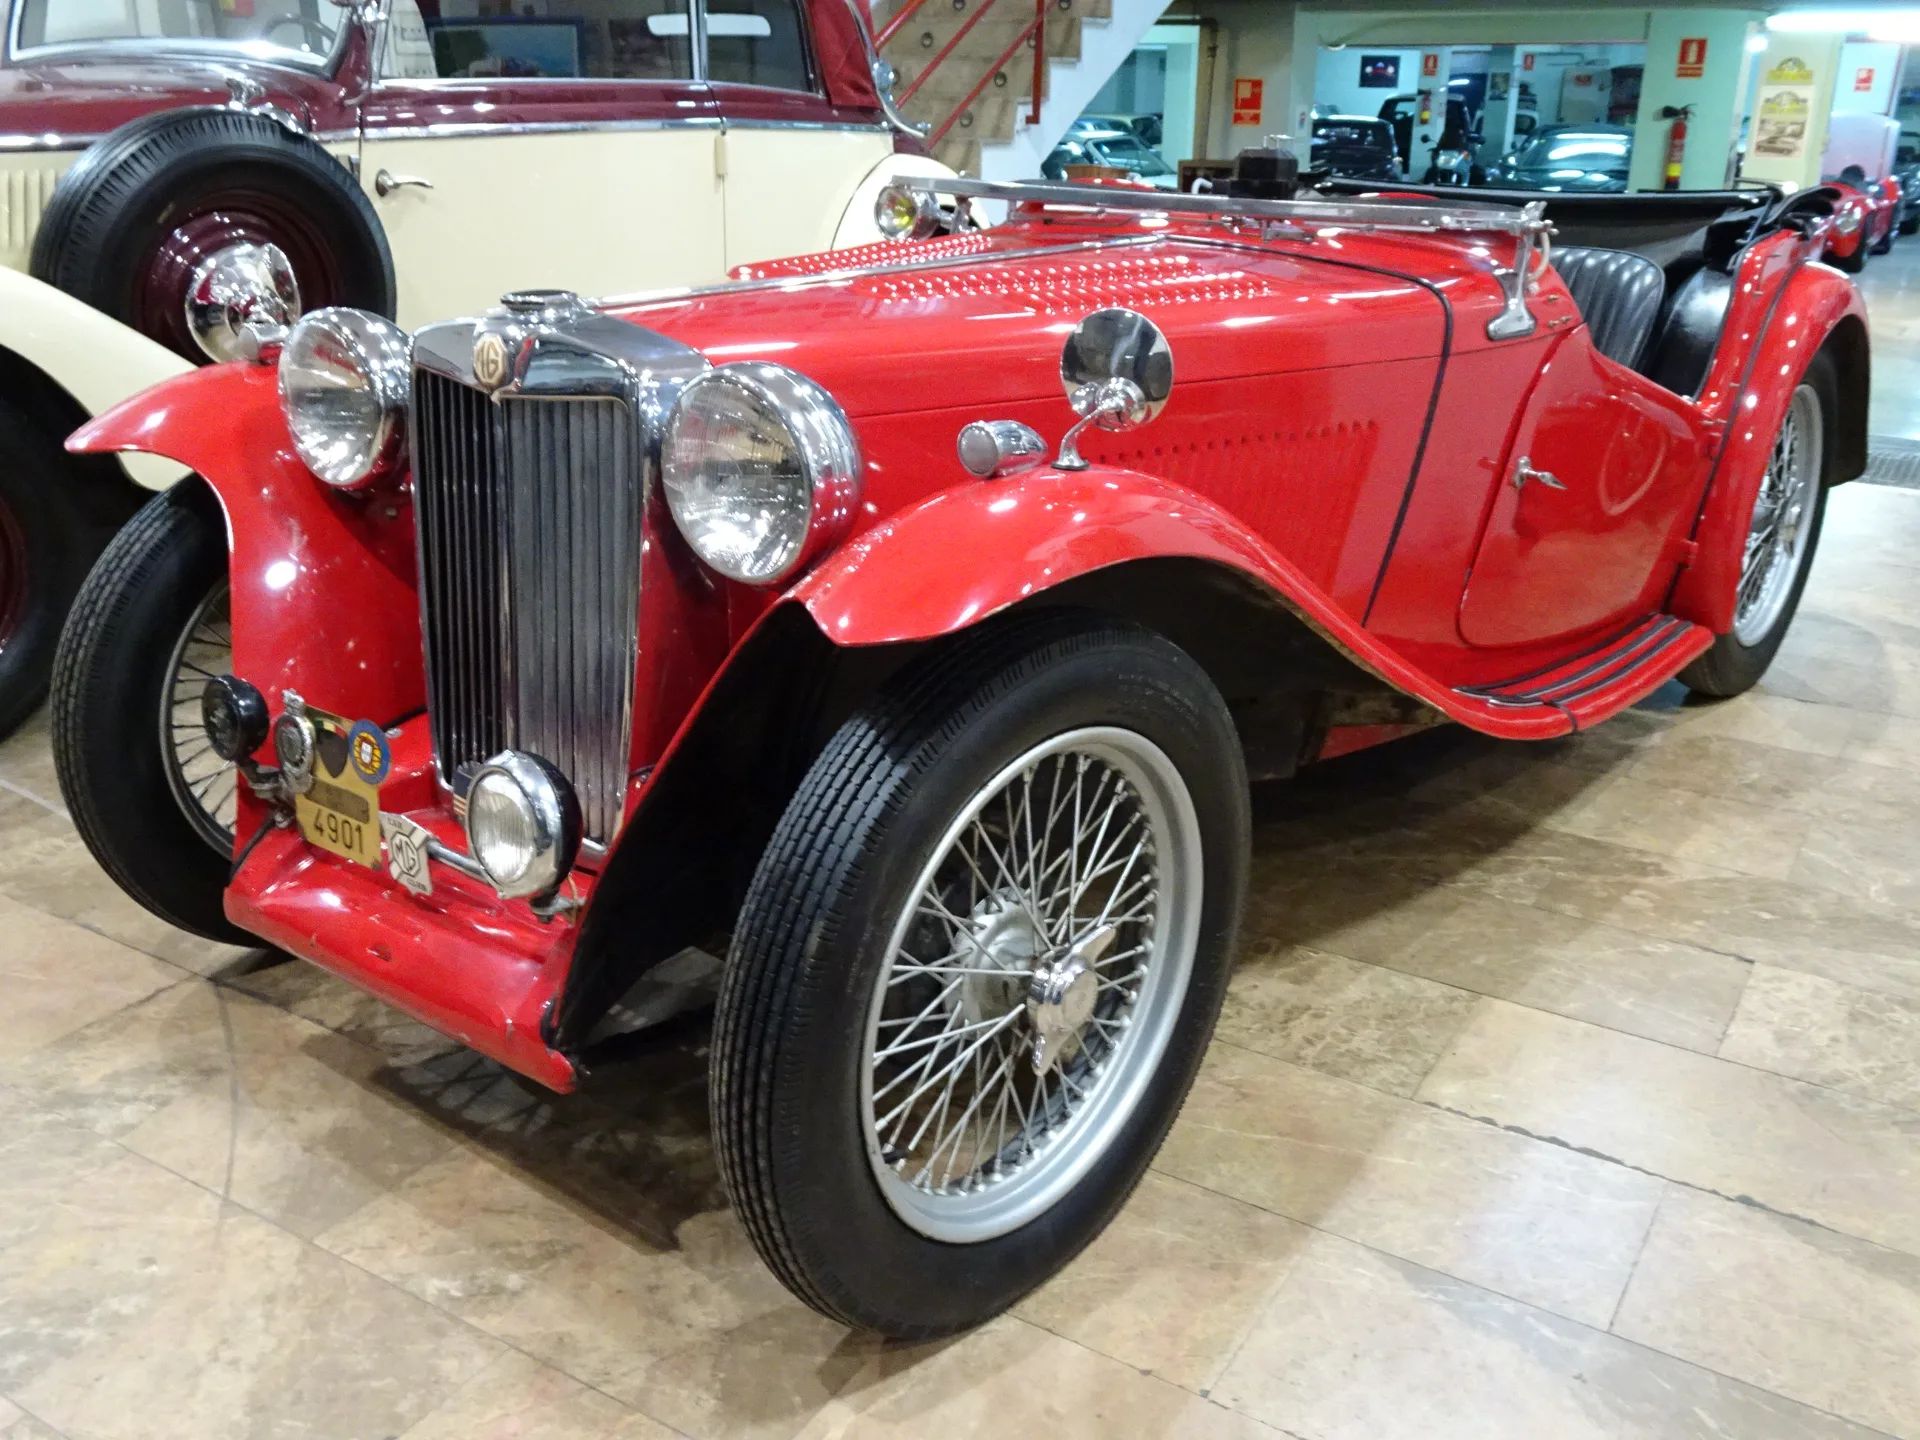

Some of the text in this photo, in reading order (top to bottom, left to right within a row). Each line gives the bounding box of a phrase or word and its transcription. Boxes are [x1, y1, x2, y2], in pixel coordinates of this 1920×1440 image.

[476, 341, 499, 379] MG
[314, 808, 363, 854] 4901
[395, 839, 417, 873] MG
